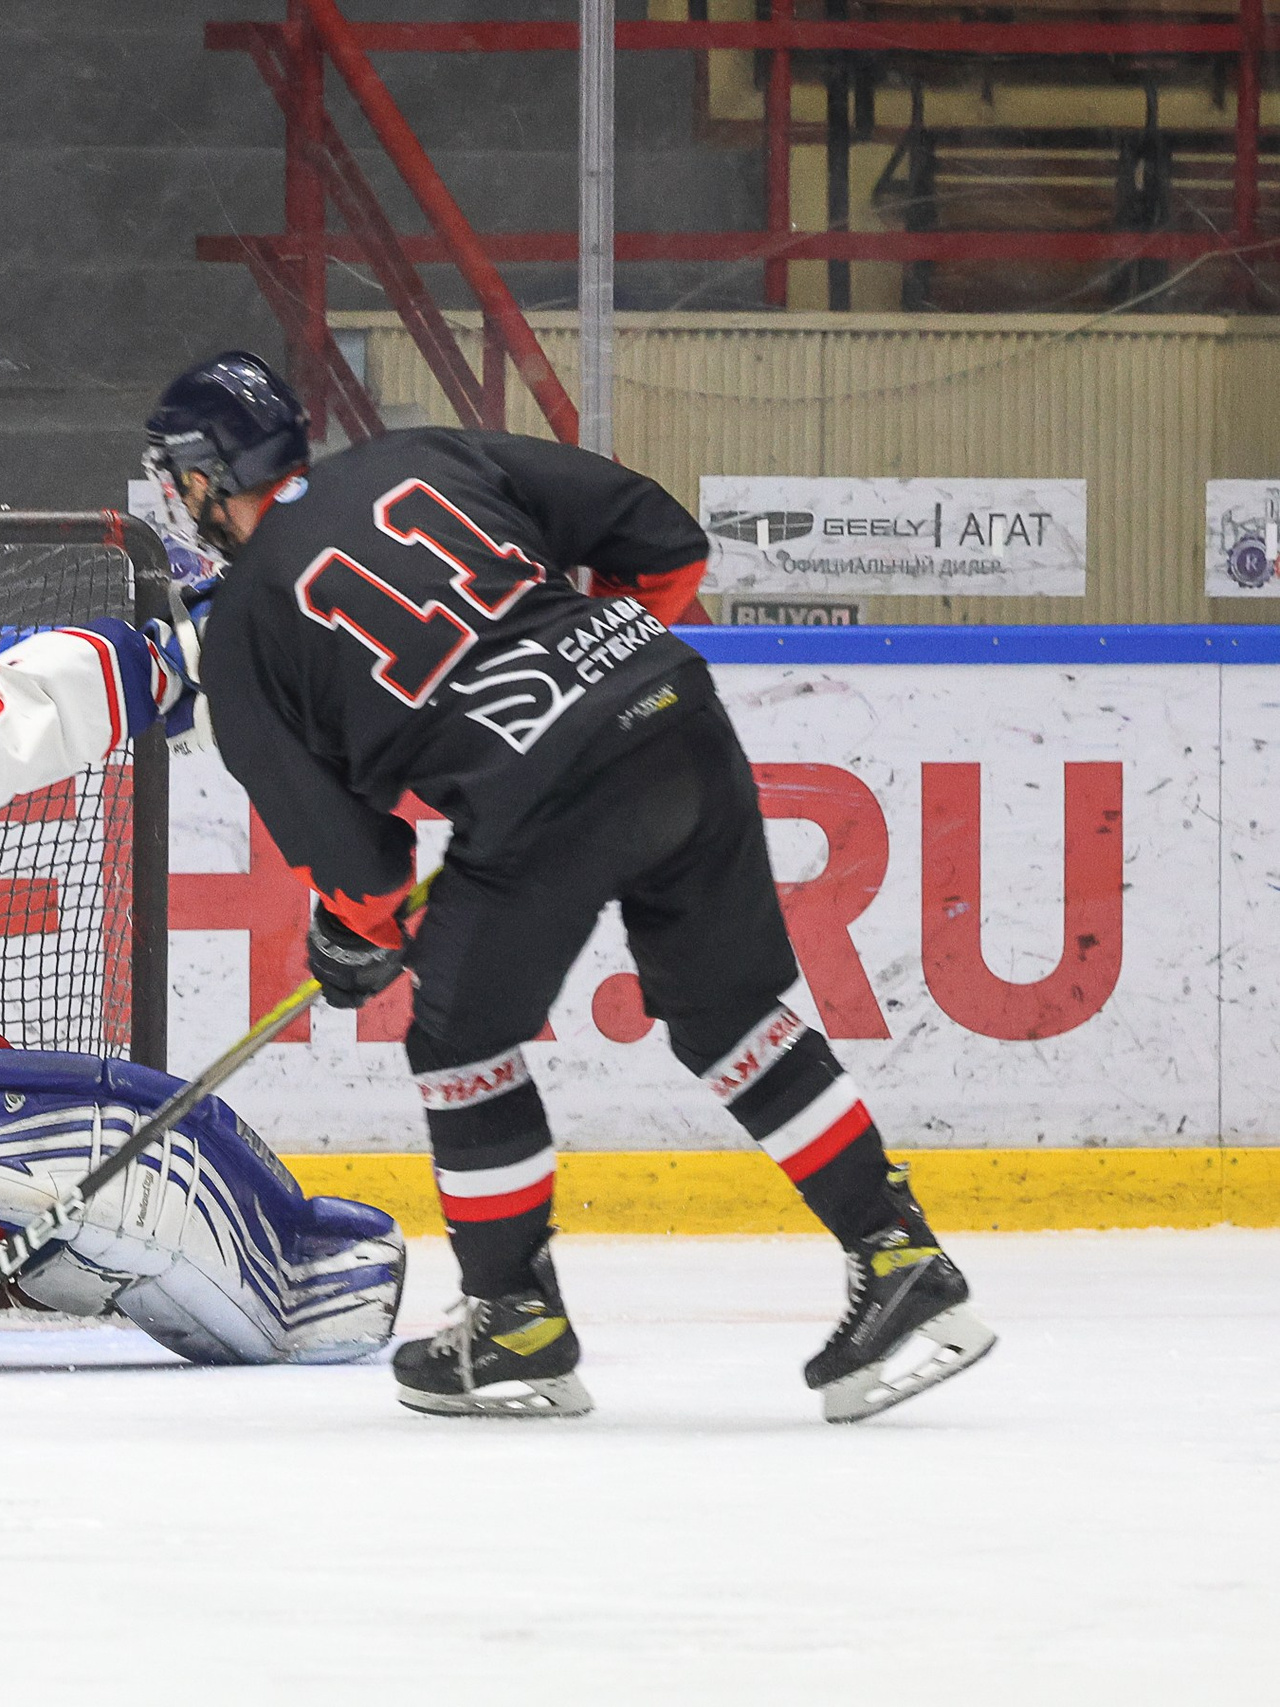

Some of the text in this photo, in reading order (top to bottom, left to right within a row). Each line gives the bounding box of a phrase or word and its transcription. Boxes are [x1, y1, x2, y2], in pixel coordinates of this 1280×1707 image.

[822, 512, 1053, 547] GEELY АГАТ
[783, 554, 1006, 578] ОФИЦИАЛЬНЫЙ ДИЛЕР
[294, 477, 547, 710] 11
